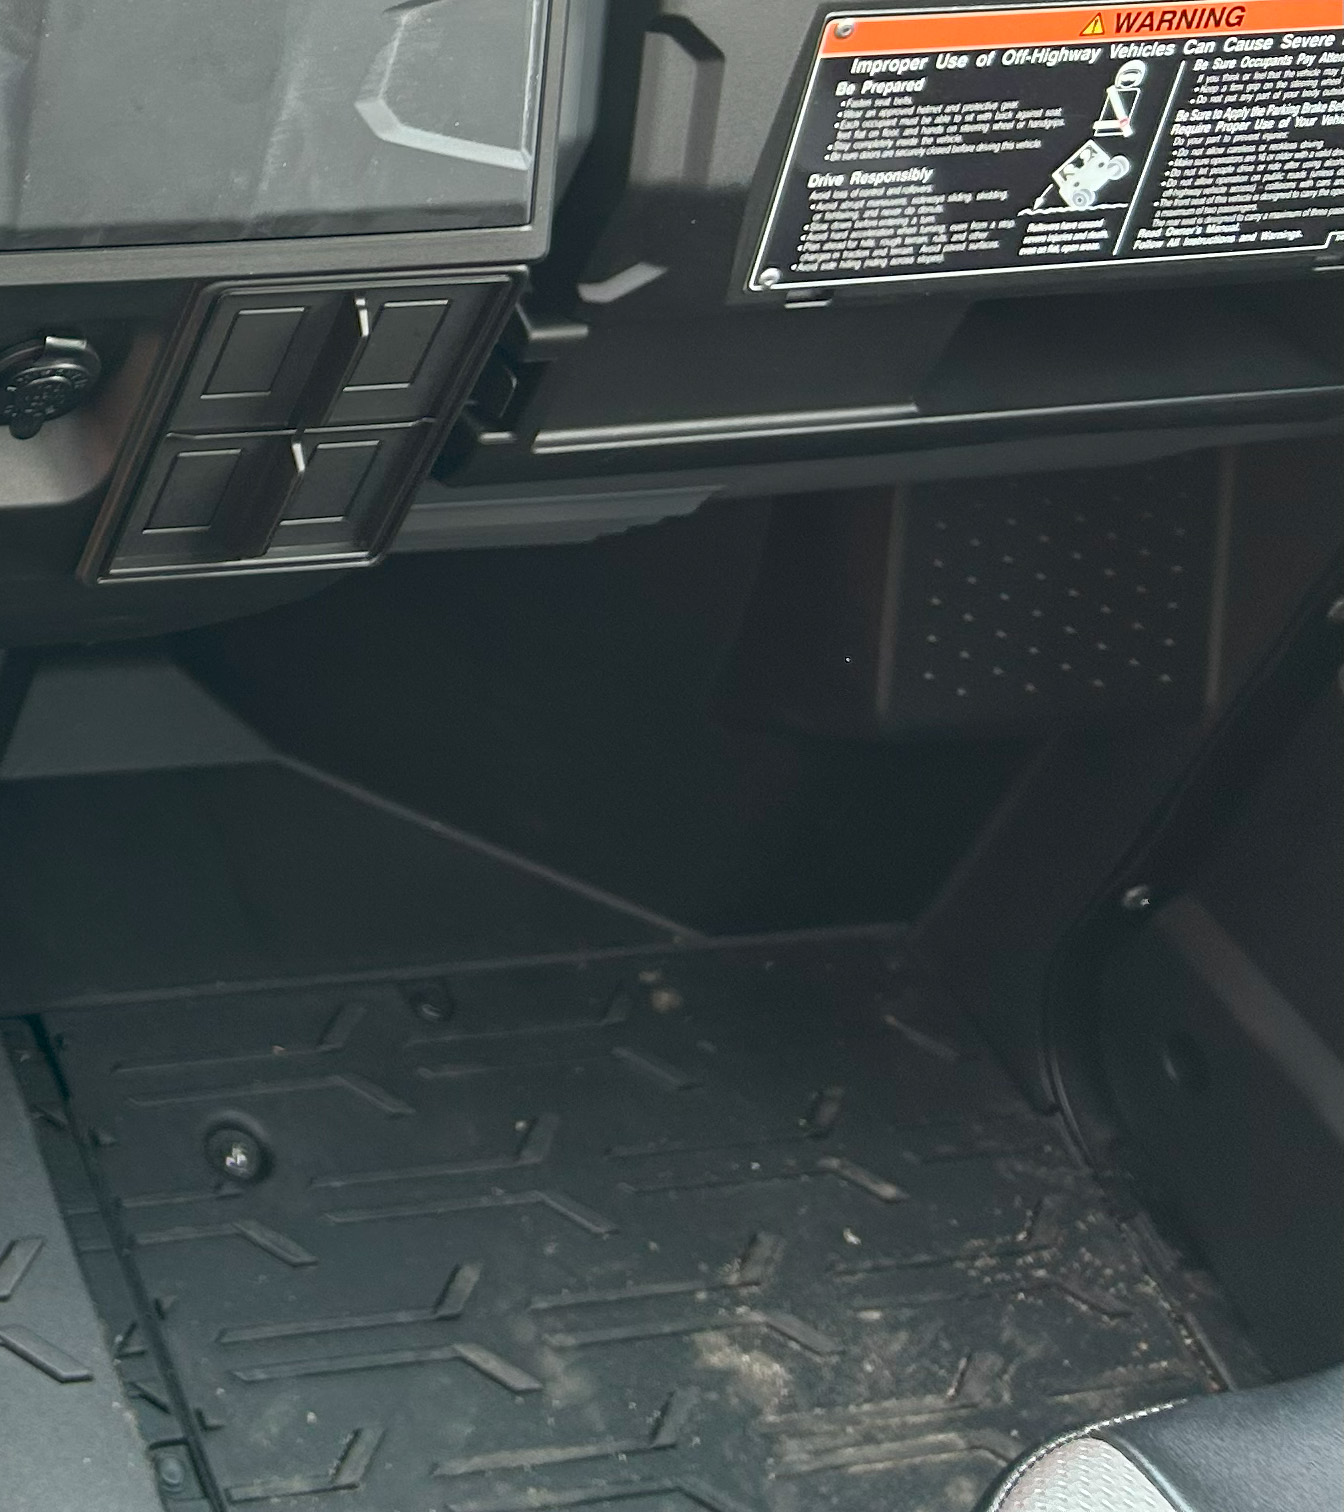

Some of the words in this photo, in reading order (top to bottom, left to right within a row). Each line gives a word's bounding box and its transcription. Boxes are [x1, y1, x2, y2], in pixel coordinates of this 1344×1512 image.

[1115, 5, 1246, 33] WARNING
[850, 57, 929, 76] Improper
[935, 52, 969, 69] Use
[975, 50, 996, 68] of
[1001, 47, 1102, 67] Off-Highway
[1110, 42, 1175, 59] Vehicles
[1183, 38, 1216, 55] Can
[1223, 35, 1274, 53] Cause
[1280, 33, 1336, 49] Severe
[1193, 58, 1209, 71] Be
[1212, 58, 1237, 71] Sure
[1240, 54, 1293, 69] Occupants
[1296, 52, 1316, 67] Pay
[835, 80, 856, 96] Be
[860, 76, 929, 96] Prepared
[1215, 120, 1252, 135] Proper
[1294, 116, 1319, 129] Your
[807, 173, 845, 188] Drive
[849, 167, 934, 186] Responsibly
